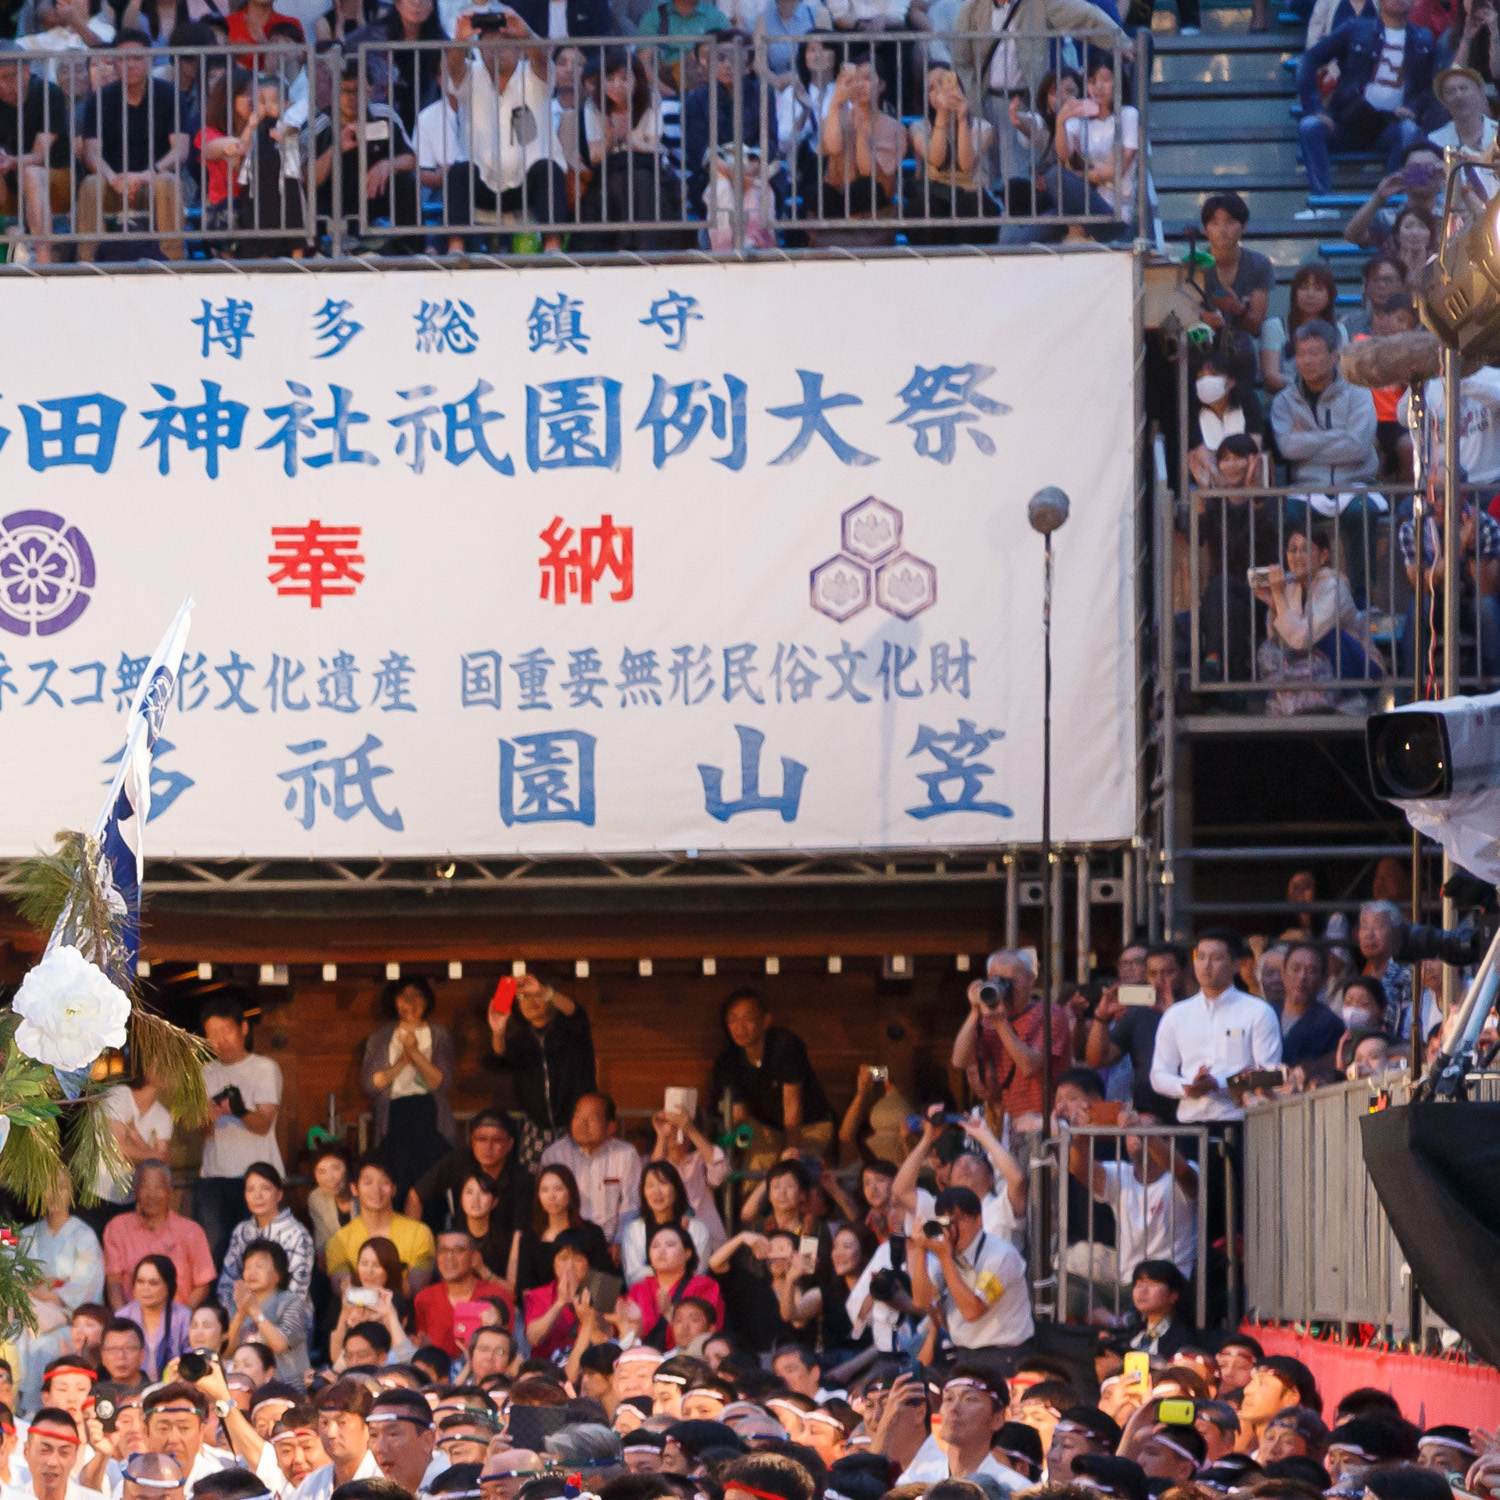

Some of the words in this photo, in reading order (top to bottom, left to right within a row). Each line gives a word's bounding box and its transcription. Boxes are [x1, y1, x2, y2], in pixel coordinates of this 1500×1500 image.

[190, 288, 706, 360] 博多総鎮守
[267, 513, 635, 610] 奉納
[460, 638, 978, 712] 国重要無形民俗文化財
